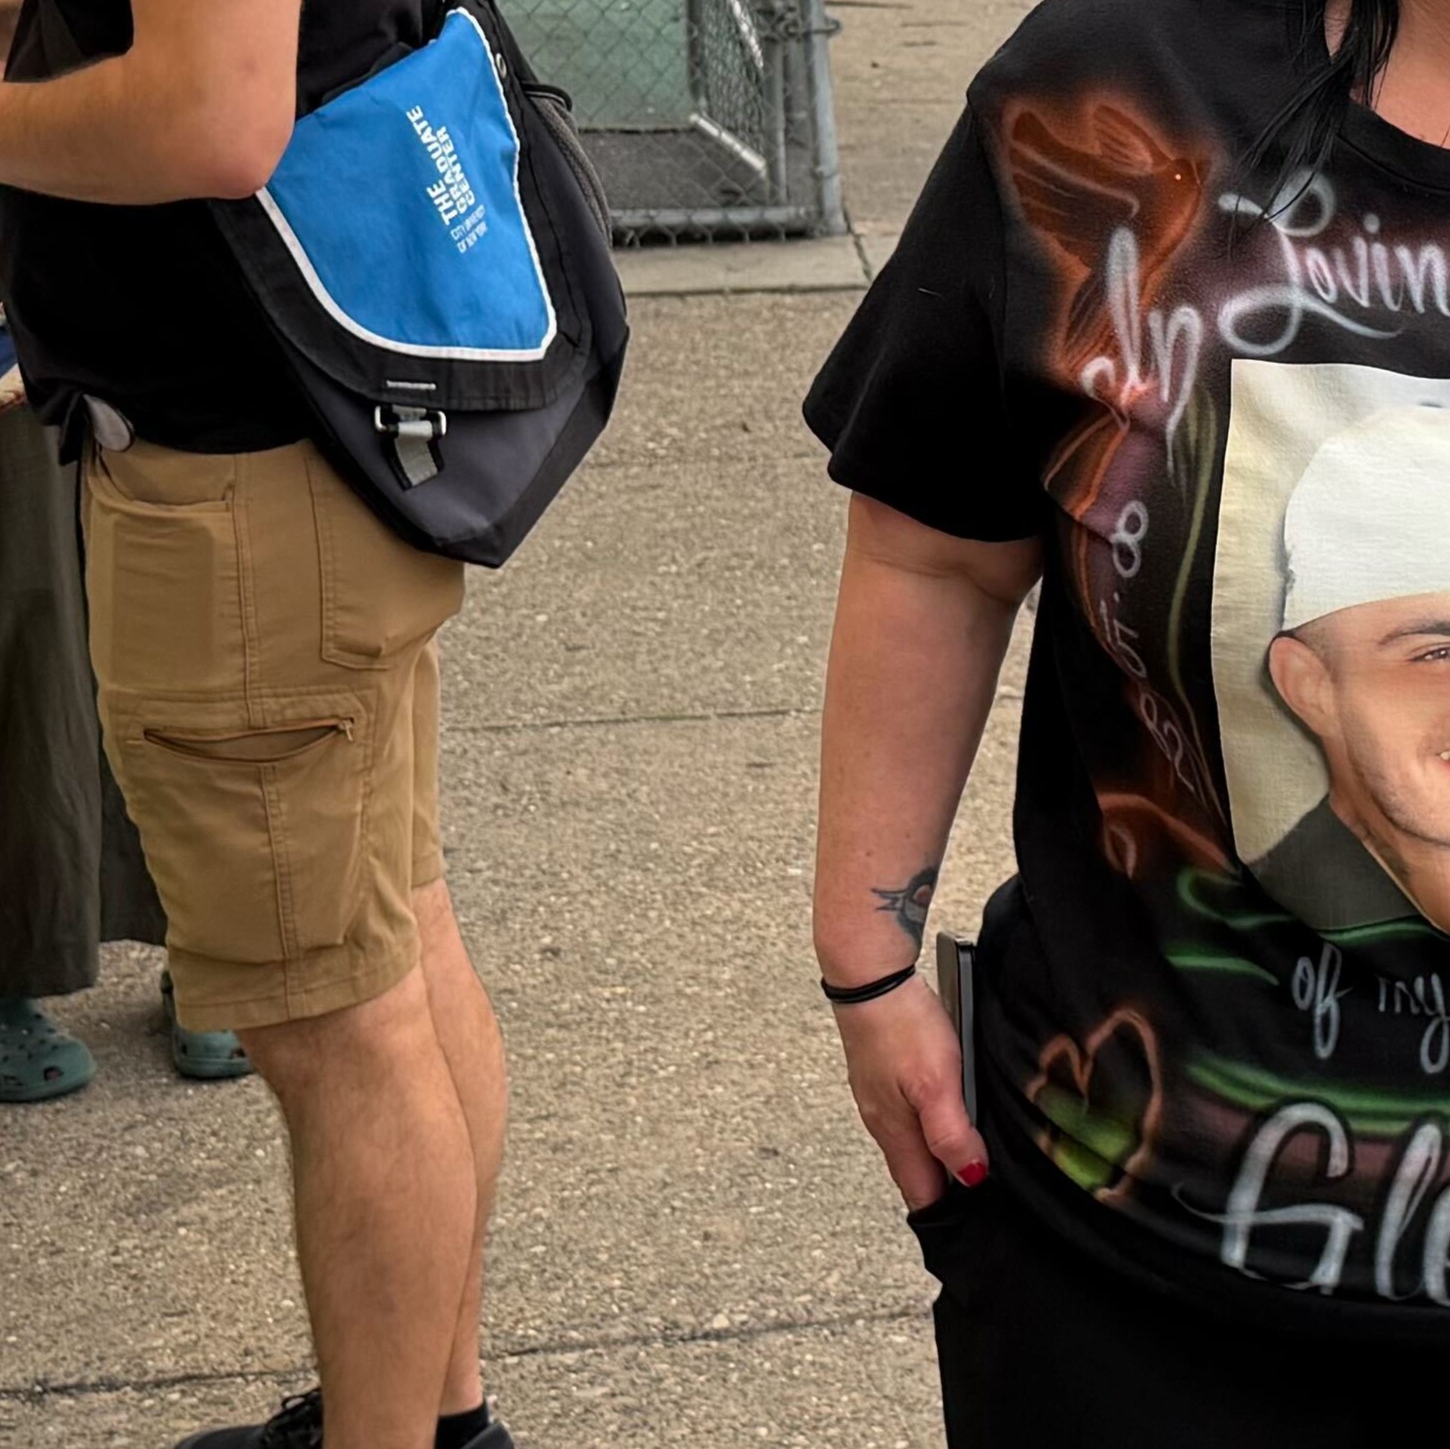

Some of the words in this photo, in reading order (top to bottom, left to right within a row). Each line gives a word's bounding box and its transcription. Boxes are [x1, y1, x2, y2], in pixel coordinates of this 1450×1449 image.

[405, 104, 470, 215] GRADUATE
[426, 179, 460, 226] THE
[436, 125, 476, 205] CENTER
[1080, 226, 1201, 465] In
[1291, 942, 1354, 1060] of
